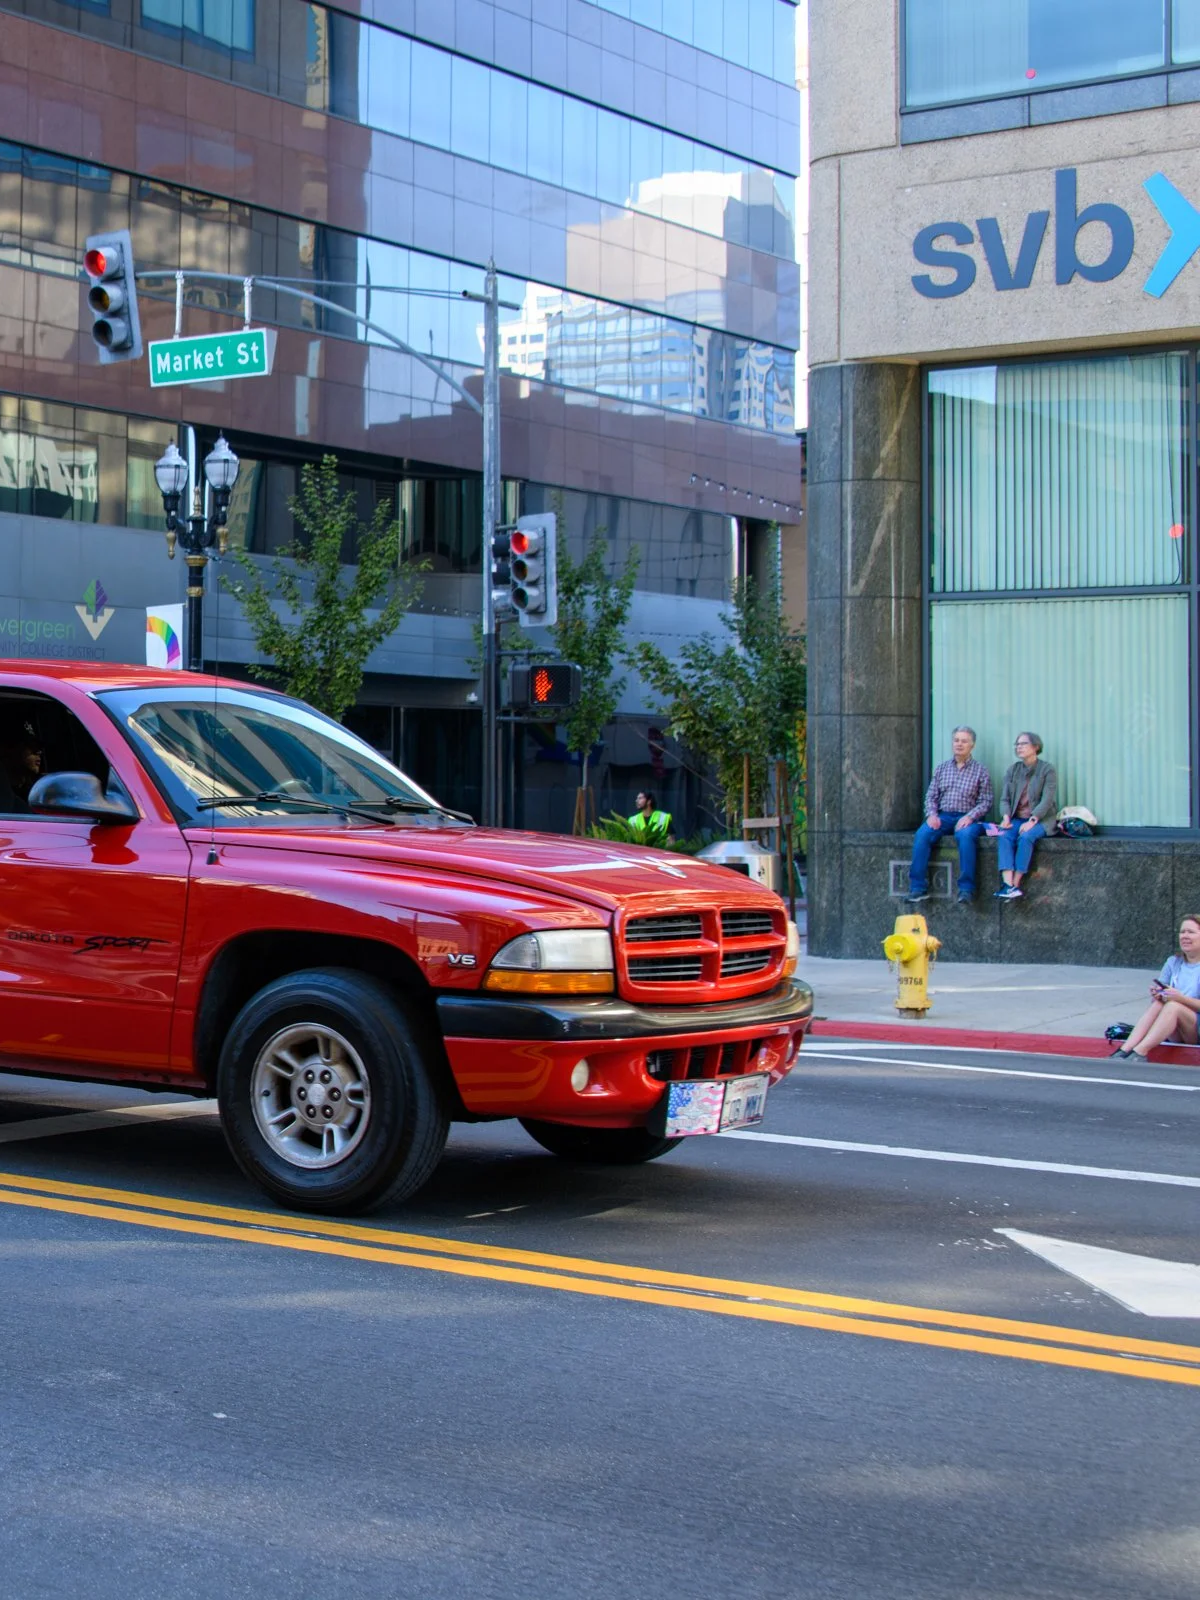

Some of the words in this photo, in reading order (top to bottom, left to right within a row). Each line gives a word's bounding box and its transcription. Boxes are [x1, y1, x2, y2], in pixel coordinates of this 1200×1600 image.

[911, 168, 1135, 299] svb
[156, 346, 224, 374] Market
[237, 341, 259, 365] St
[20, 642, 64, 657] COLLEGE
[67, 645, 105, 660] DISTRICT
[7, 931, 75, 945] DAKOTA
[73, 935, 172, 955] SPORT
[447, 953, 477, 966] V6
